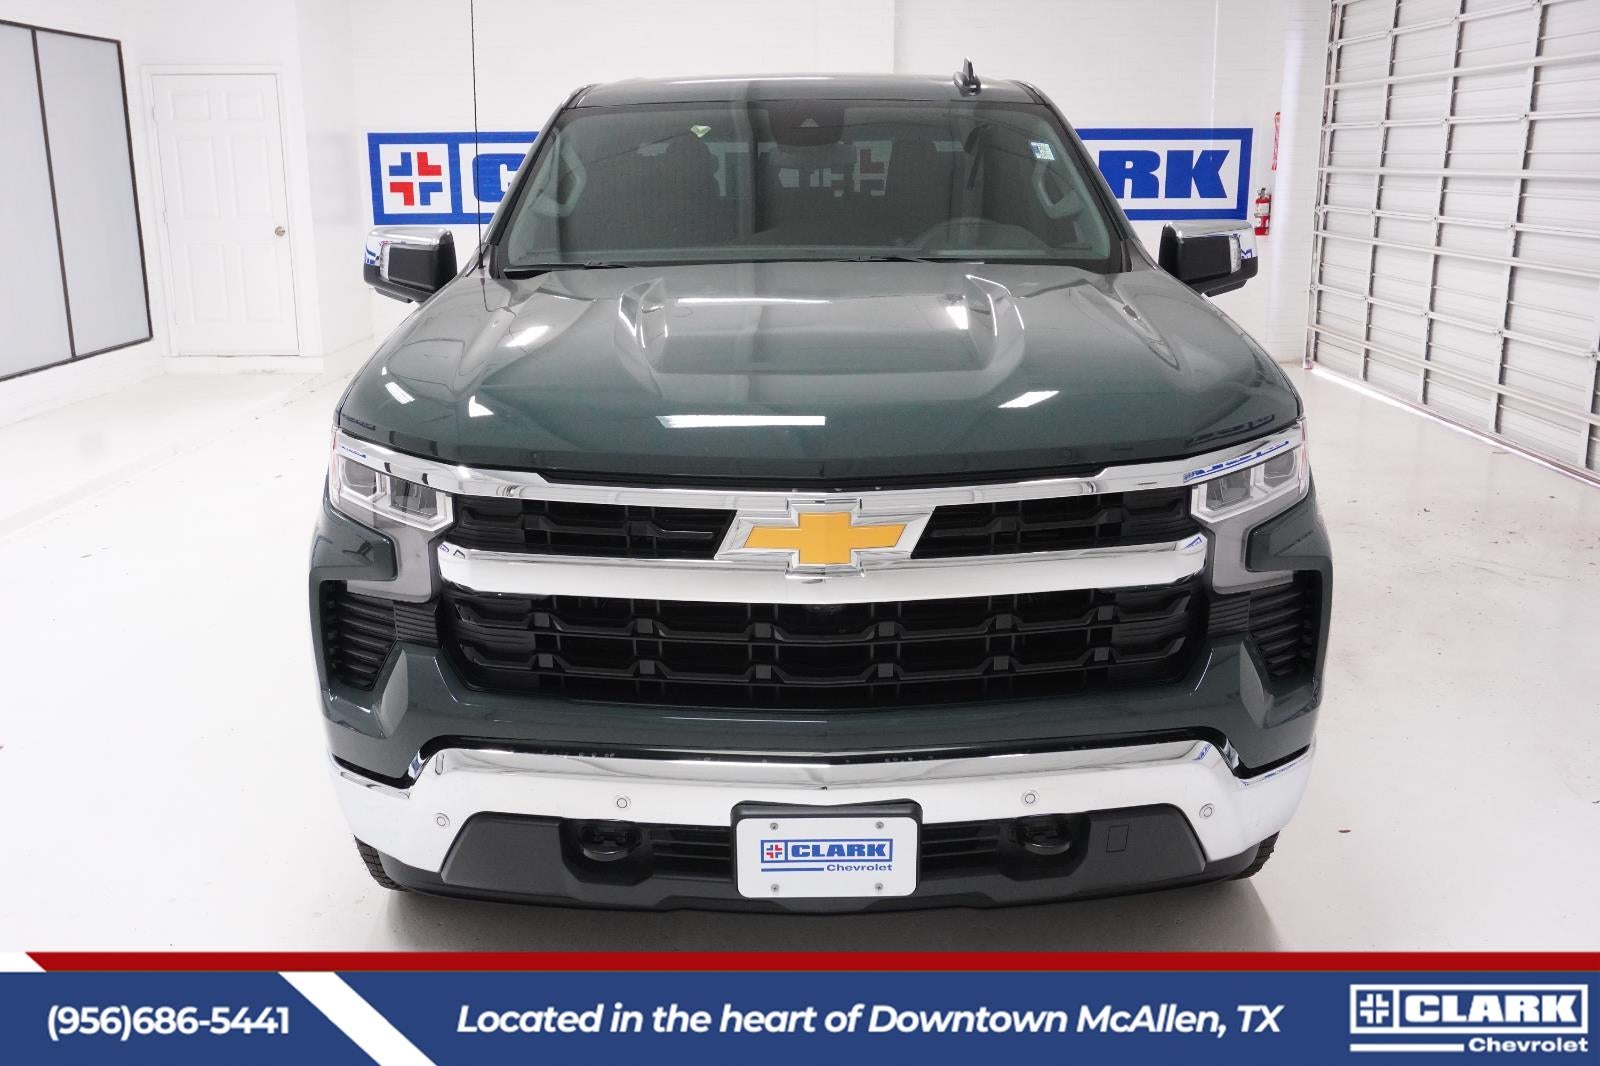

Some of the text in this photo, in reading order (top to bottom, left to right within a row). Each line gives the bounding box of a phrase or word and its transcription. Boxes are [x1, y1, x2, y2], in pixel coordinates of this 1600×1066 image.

[1098, 150, 1229, 198] RK
[790, 843, 888, 858] CLARK
[826, 864, 892, 872] Chevrolet
